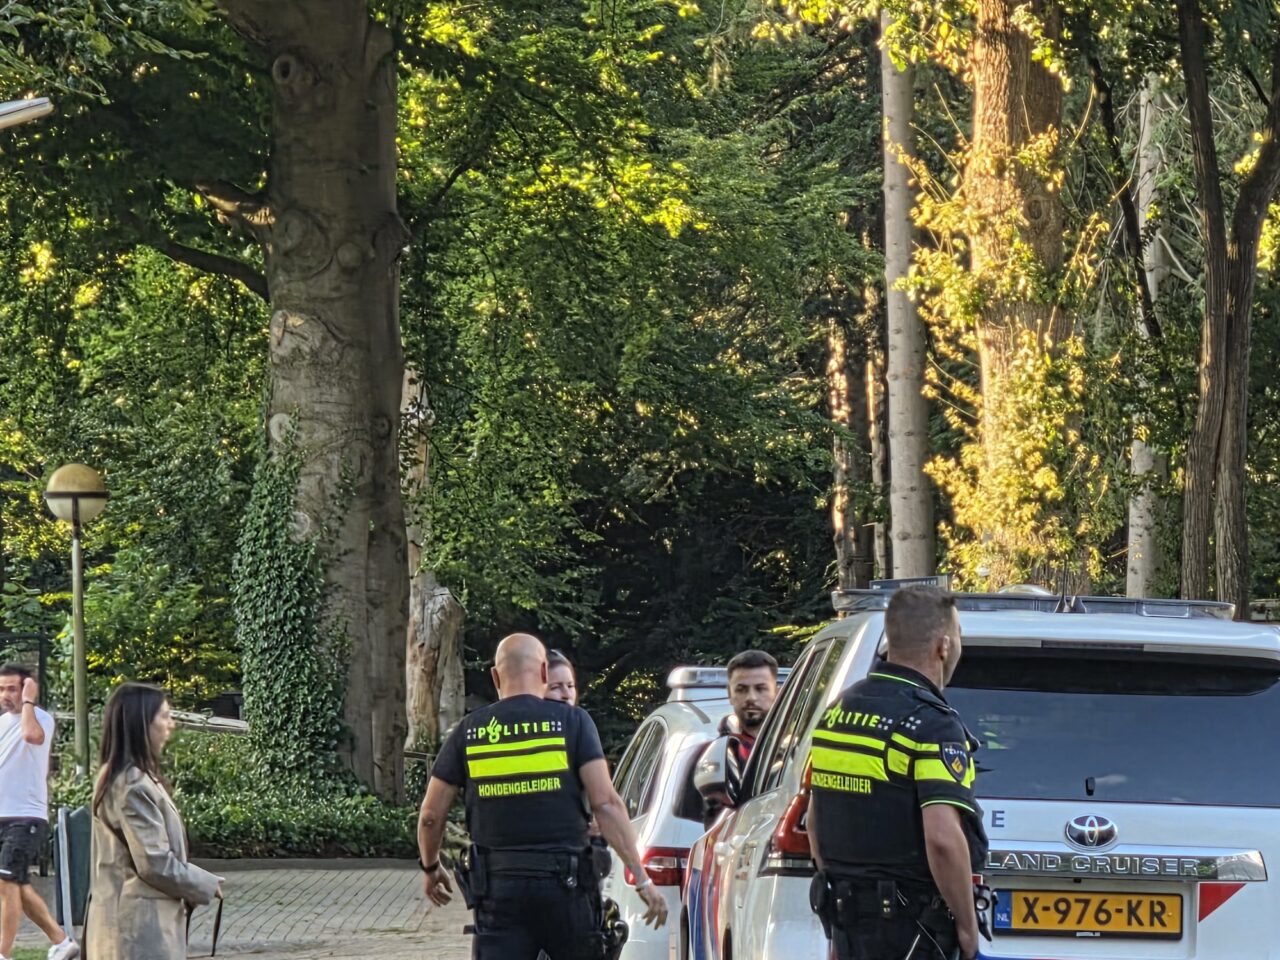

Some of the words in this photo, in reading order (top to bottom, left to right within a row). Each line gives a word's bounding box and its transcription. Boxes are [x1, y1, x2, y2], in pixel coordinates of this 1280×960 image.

[478, 717, 550, 743] POLITIE
[478, 777, 561, 797] HONDENGELEIDER
[985, 851, 1061, 872] LAND
[1071, 854, 1200, 876] CRUISER
[997, 913, 1010, 922] NL
[1022, 897, 1167, 927] X-976-KR
